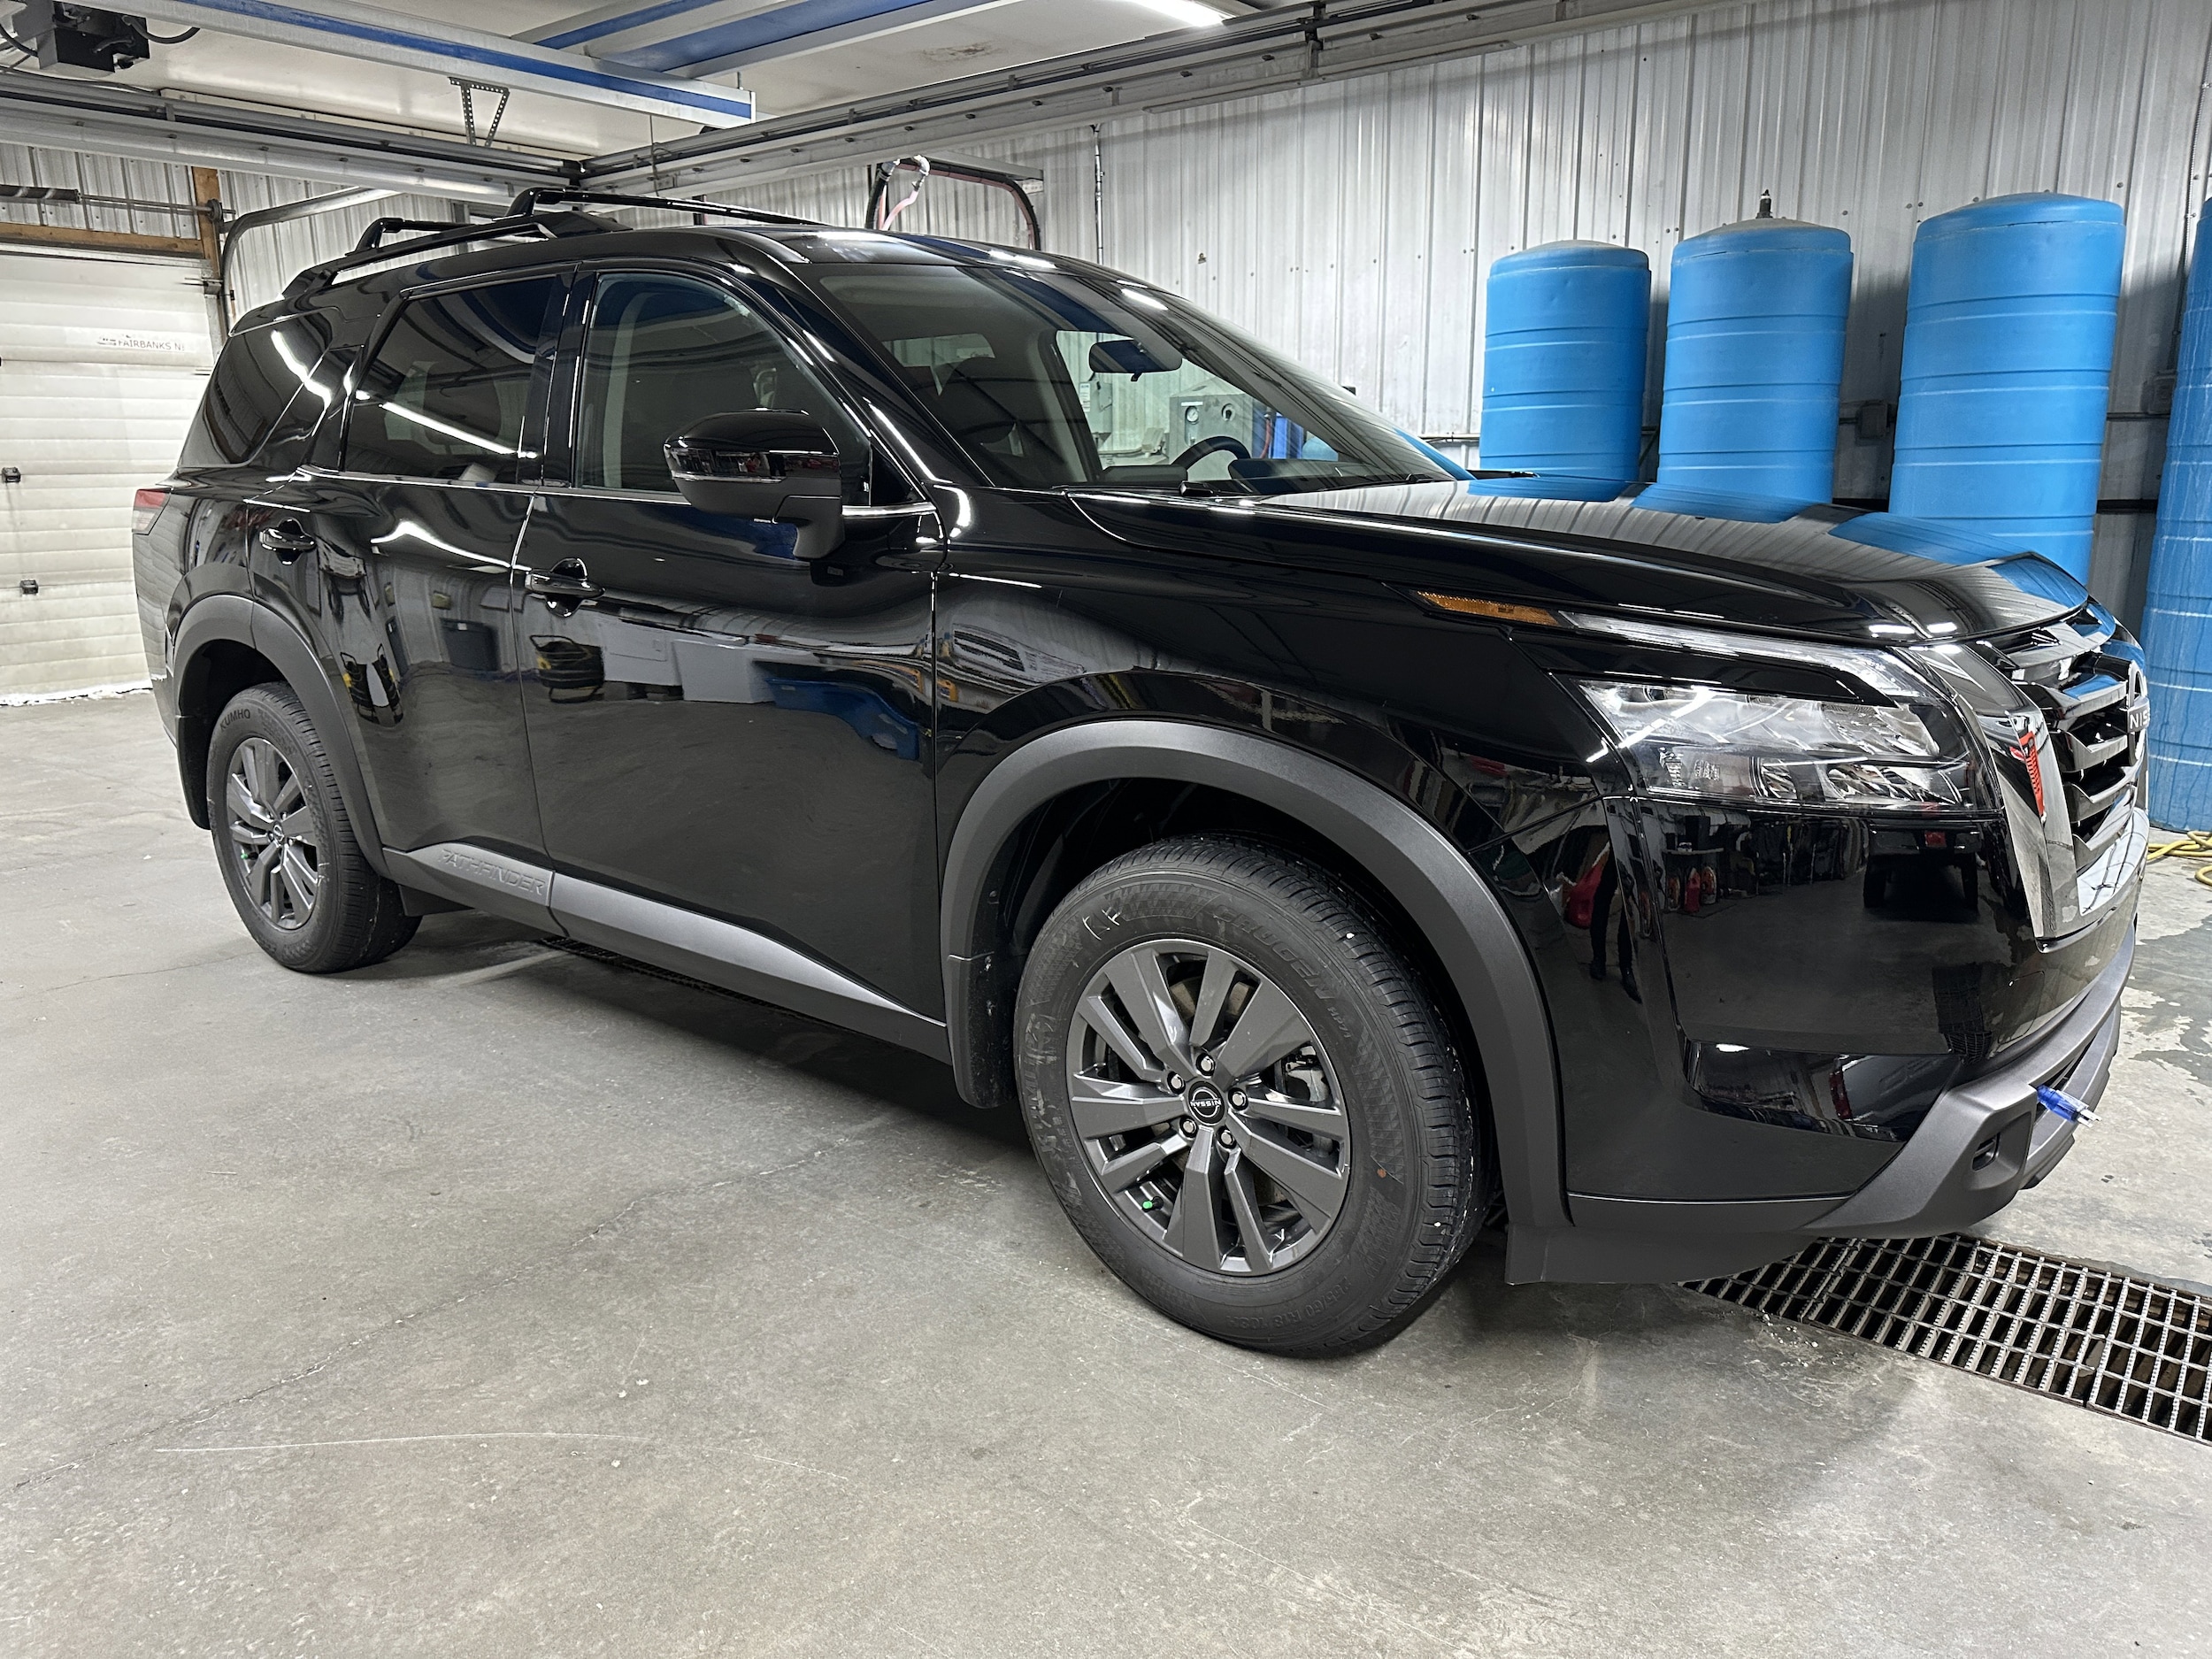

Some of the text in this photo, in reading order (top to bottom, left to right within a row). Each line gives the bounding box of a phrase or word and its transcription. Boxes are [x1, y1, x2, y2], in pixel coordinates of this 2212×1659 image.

[119, 340, 172, 350] FAIRBANKS
[219, 709, 250, 733] KUMHO
[437, 849, 546, 896] PATHFINDER
[1190, 1099, 1221, 1108] NISSAN
